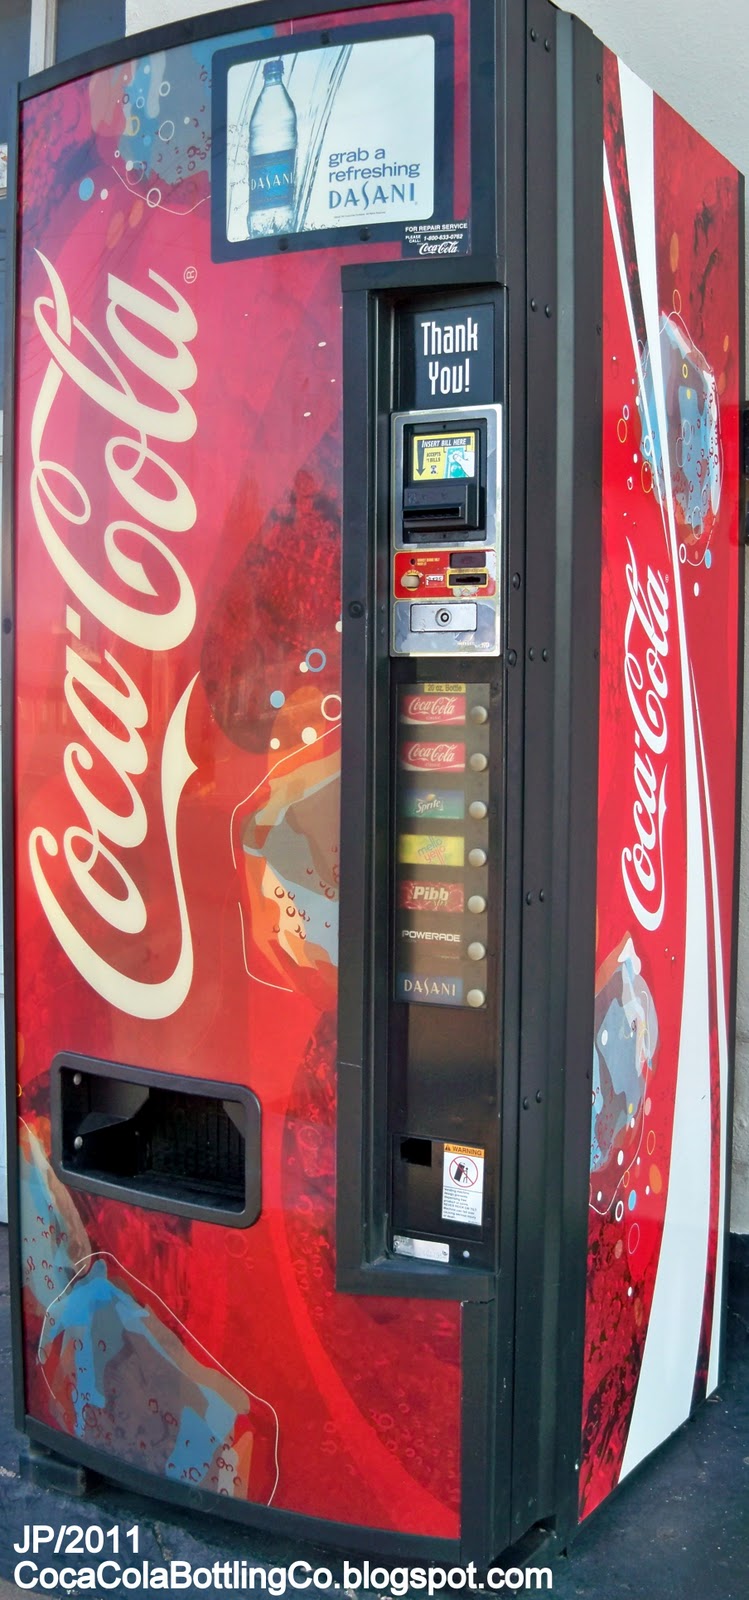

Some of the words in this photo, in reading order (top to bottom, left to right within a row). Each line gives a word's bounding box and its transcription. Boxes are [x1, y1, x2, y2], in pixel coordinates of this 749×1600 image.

[328, 148, 369, 167] grab
[374, 148, 386, 160] a
[251, 171, 294, 191] DASANI
[328, 162, 421, 183] refreshing
[328, 181, 415, 210] DASANI
[419, 224, 441, 232] REPAIR
[419, 241, 459, 255] Coca-Cola
[421, 317, 478, 356] Thank
[428, 358, 470, 395] You!
[28, 248, 200, 1020] Coca-Cola
[445, 684, 462, 692] Bottle
[408, 697, 458, 715] Coca-Cola
[621, 536, 669, 931] Coca-Cola
[408, 743, 458, 762] Coca-Cola
[416, 799, 441, 813] Sprite
[418, 836, 442, 856] mello
[424, 845, 446, 864] yello
[413, 886, 449, 901] Pibb
[402, 930, 461, 942] POWERADE
[404, 977, 456, 997] DASANI
[452, 1146, 482, 1156] WARNING
